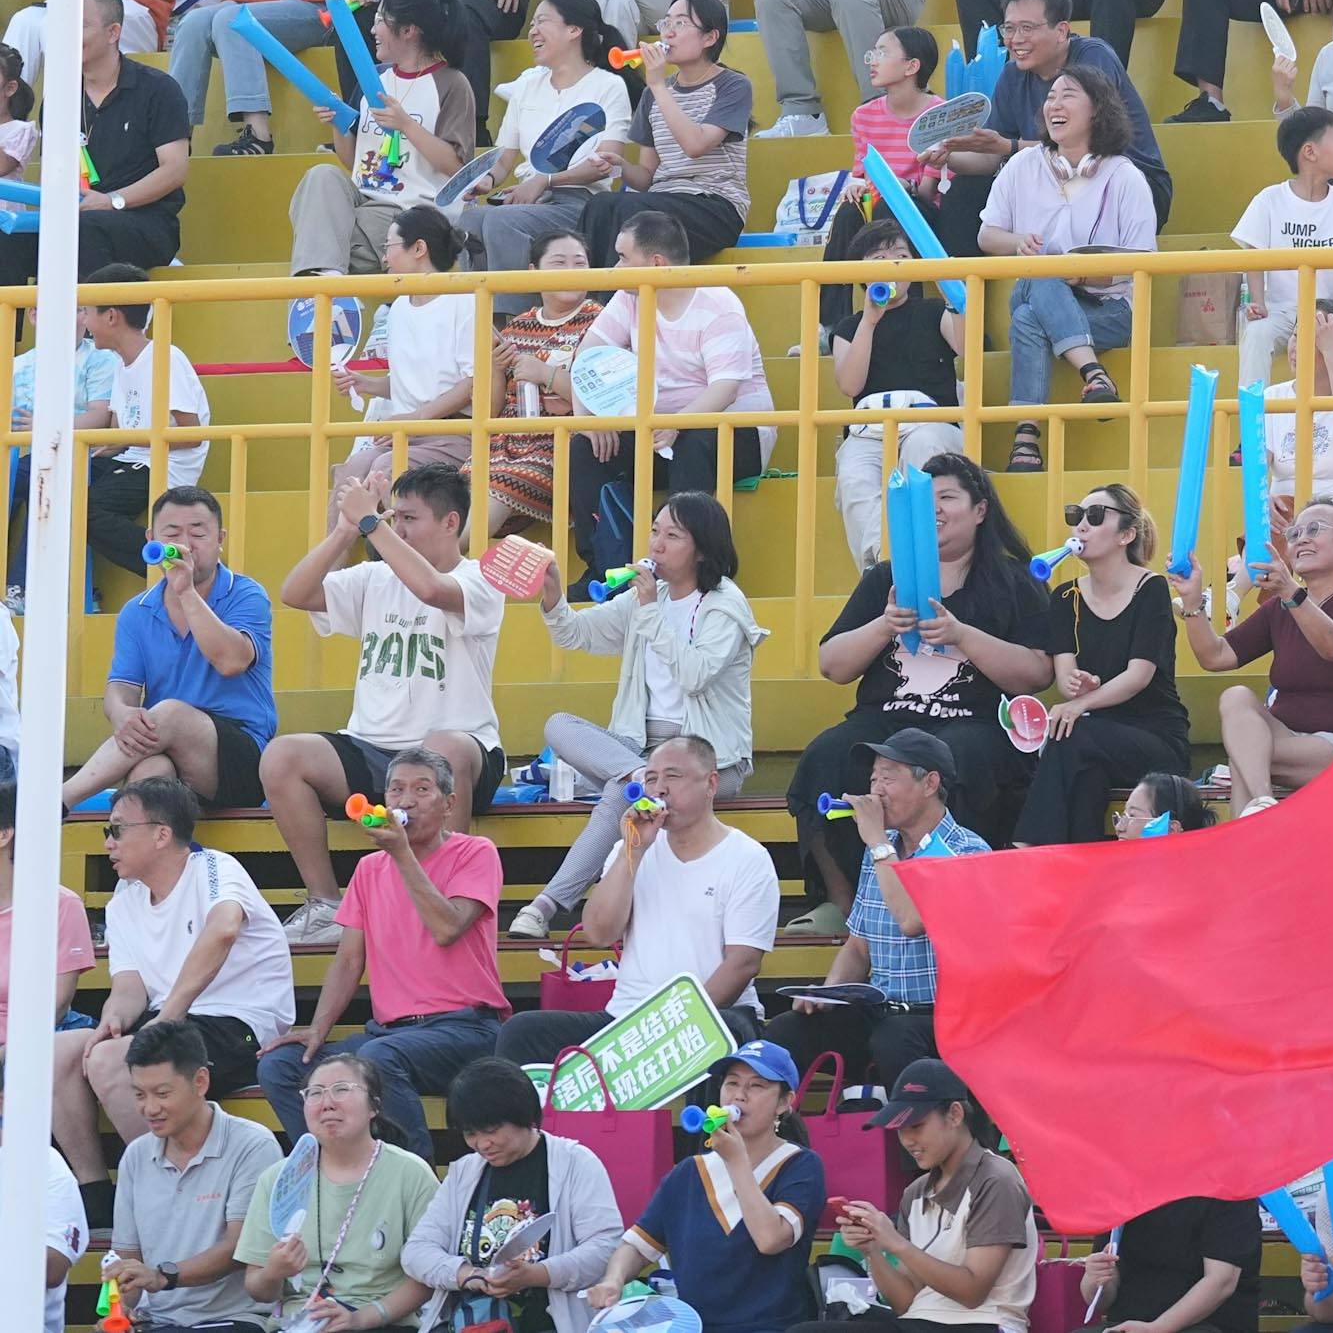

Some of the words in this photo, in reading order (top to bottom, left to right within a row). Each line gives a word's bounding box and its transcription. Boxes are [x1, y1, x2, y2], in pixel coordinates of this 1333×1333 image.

[1281, 222, 1317, 236] JUMP
[883, 700, 927, 714] LITTLE
[928, 702, 973, 718] DEVIL
[554, 992, 690, 1107] 落后不是结束
